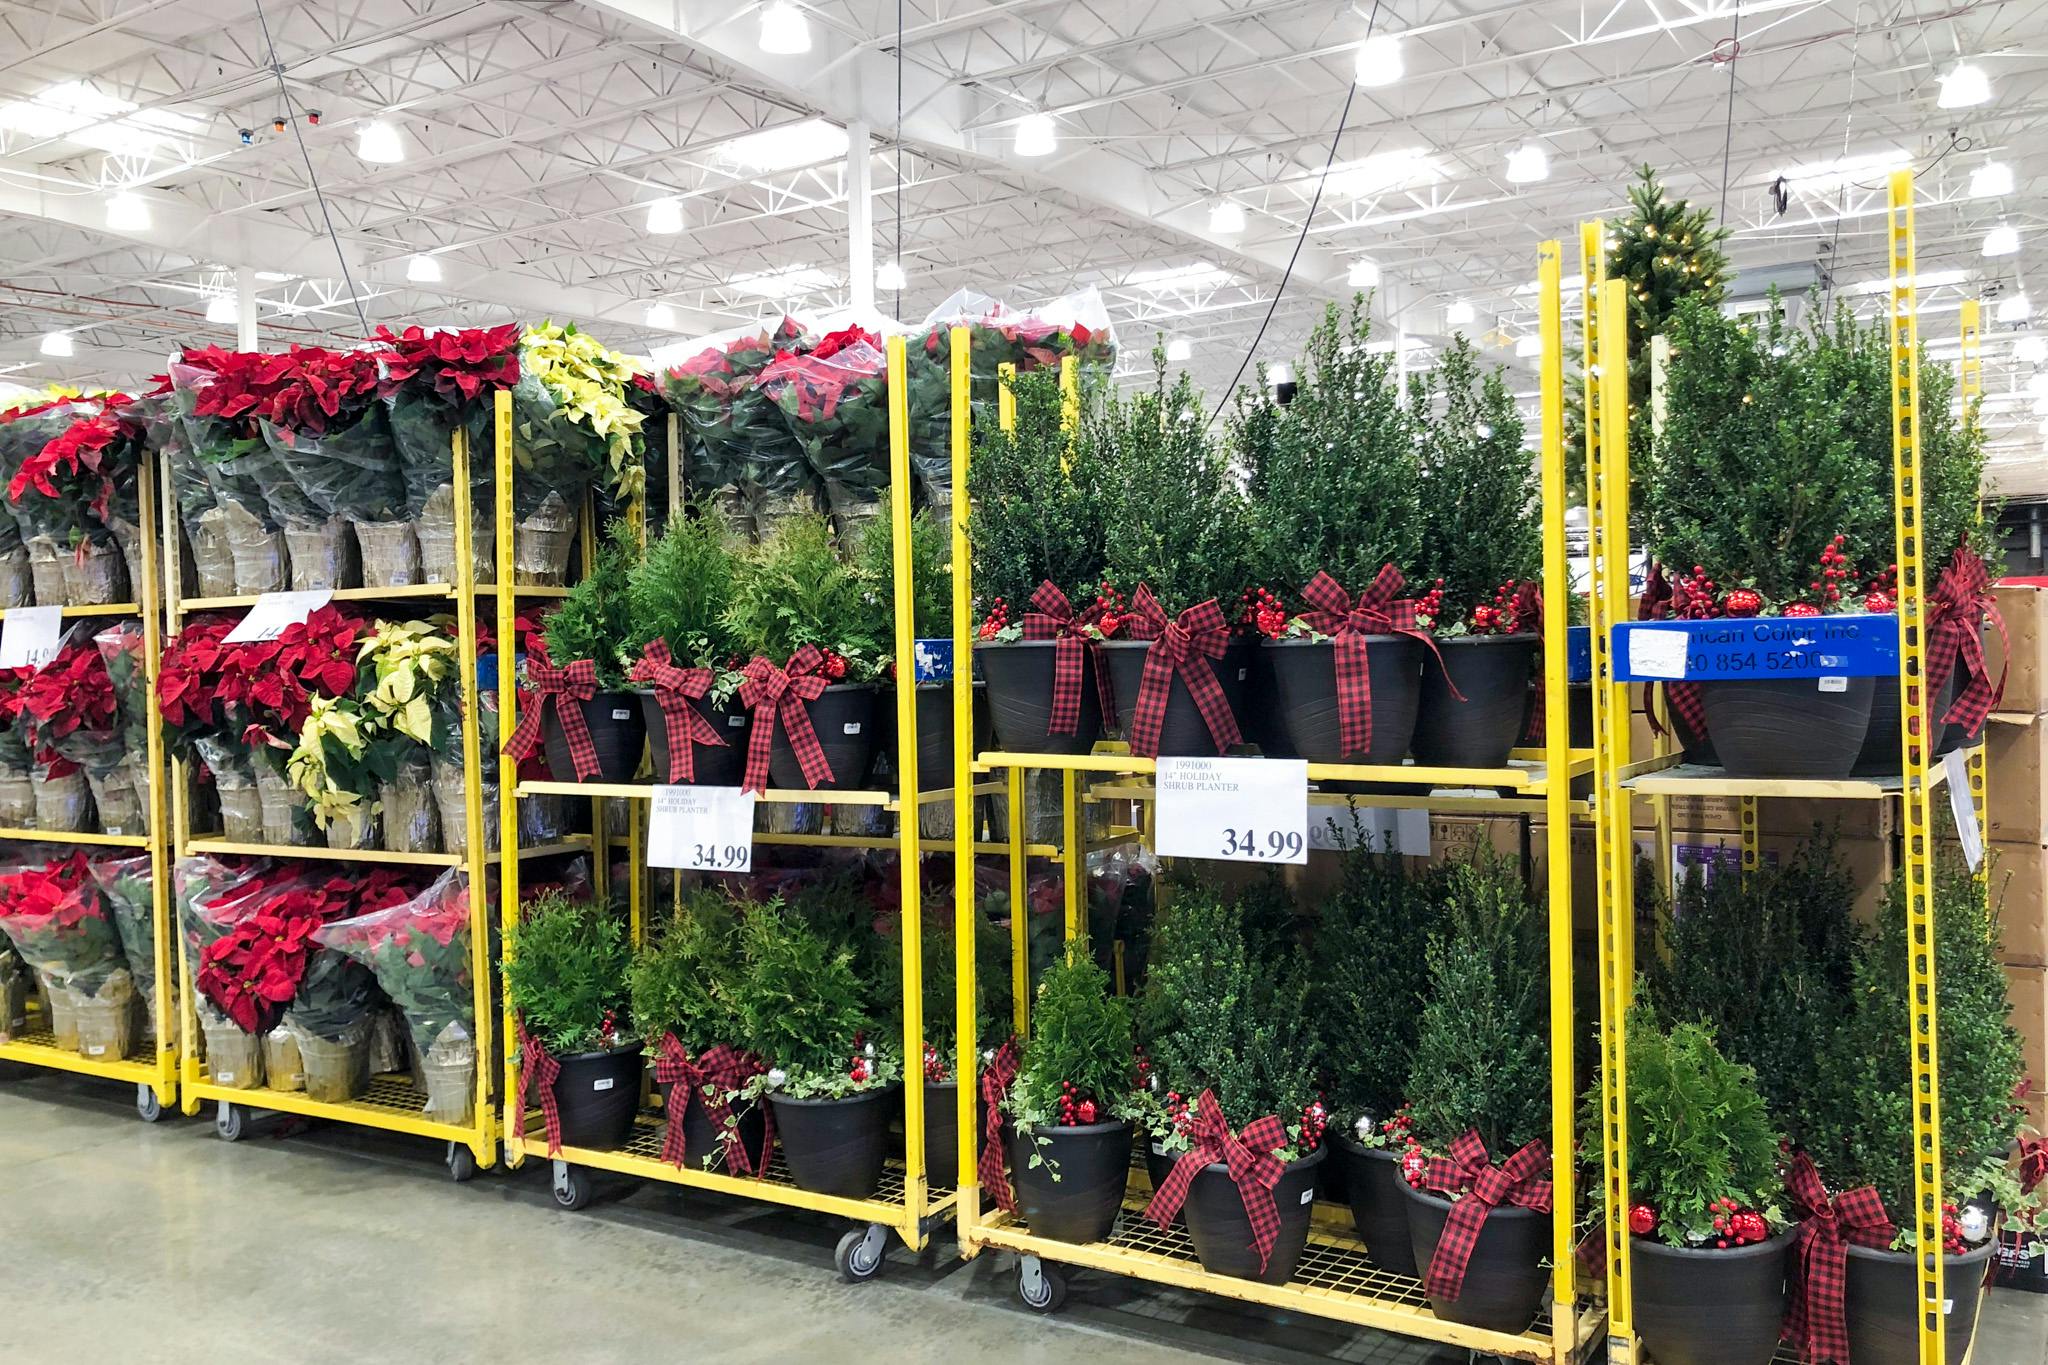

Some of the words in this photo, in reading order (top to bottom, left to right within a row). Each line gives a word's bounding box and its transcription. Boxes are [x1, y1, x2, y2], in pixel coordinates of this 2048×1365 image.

[1690, 626, 1745, 643] rican
[1754, 623, 1816, 642] Color
[1823, 622, 1859, 640] Inc
[1716, 651, 1757, 671] 854
[1176, 760, 1212, 770] 1991000
[1179, 772, 1222, 781] HOLIDAY
[1163, 781, 1194, 790] SHRUB
[1196, 782, 1239, 791] PLANTER
[668, 797, 697, 806] HOLIDAY
[679, 806, 709, 815] PLANTER
[1221, 828, 1303, 859] 34.99
[692, 843, 748, 869] 34.99
